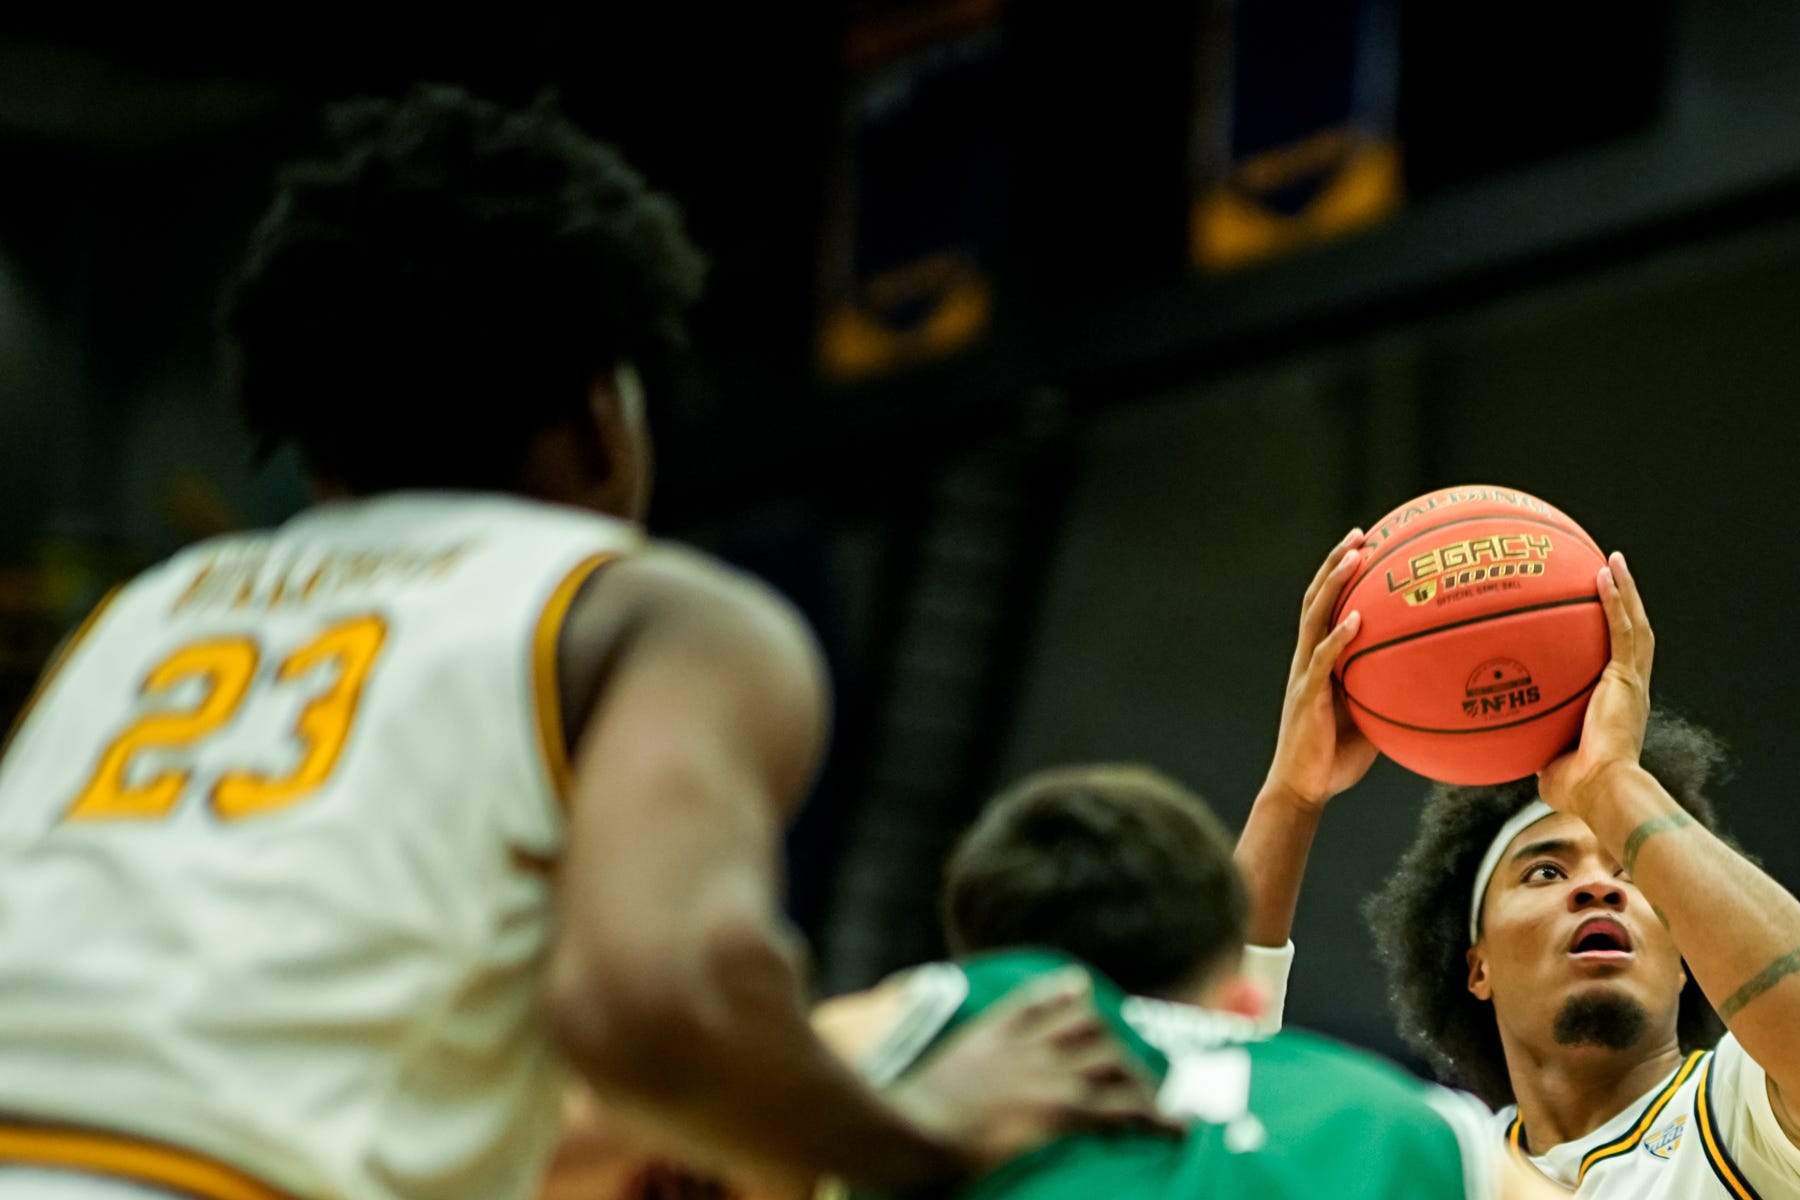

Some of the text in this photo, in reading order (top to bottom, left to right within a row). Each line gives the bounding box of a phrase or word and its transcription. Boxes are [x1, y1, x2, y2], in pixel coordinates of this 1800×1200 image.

[1386, 534, 1554, 593] LEGACY
[1442, 561, 1545, 591] 1000
[64, 612, 388, 822] 23
[1480, 685, 1540, 715] NFHS
